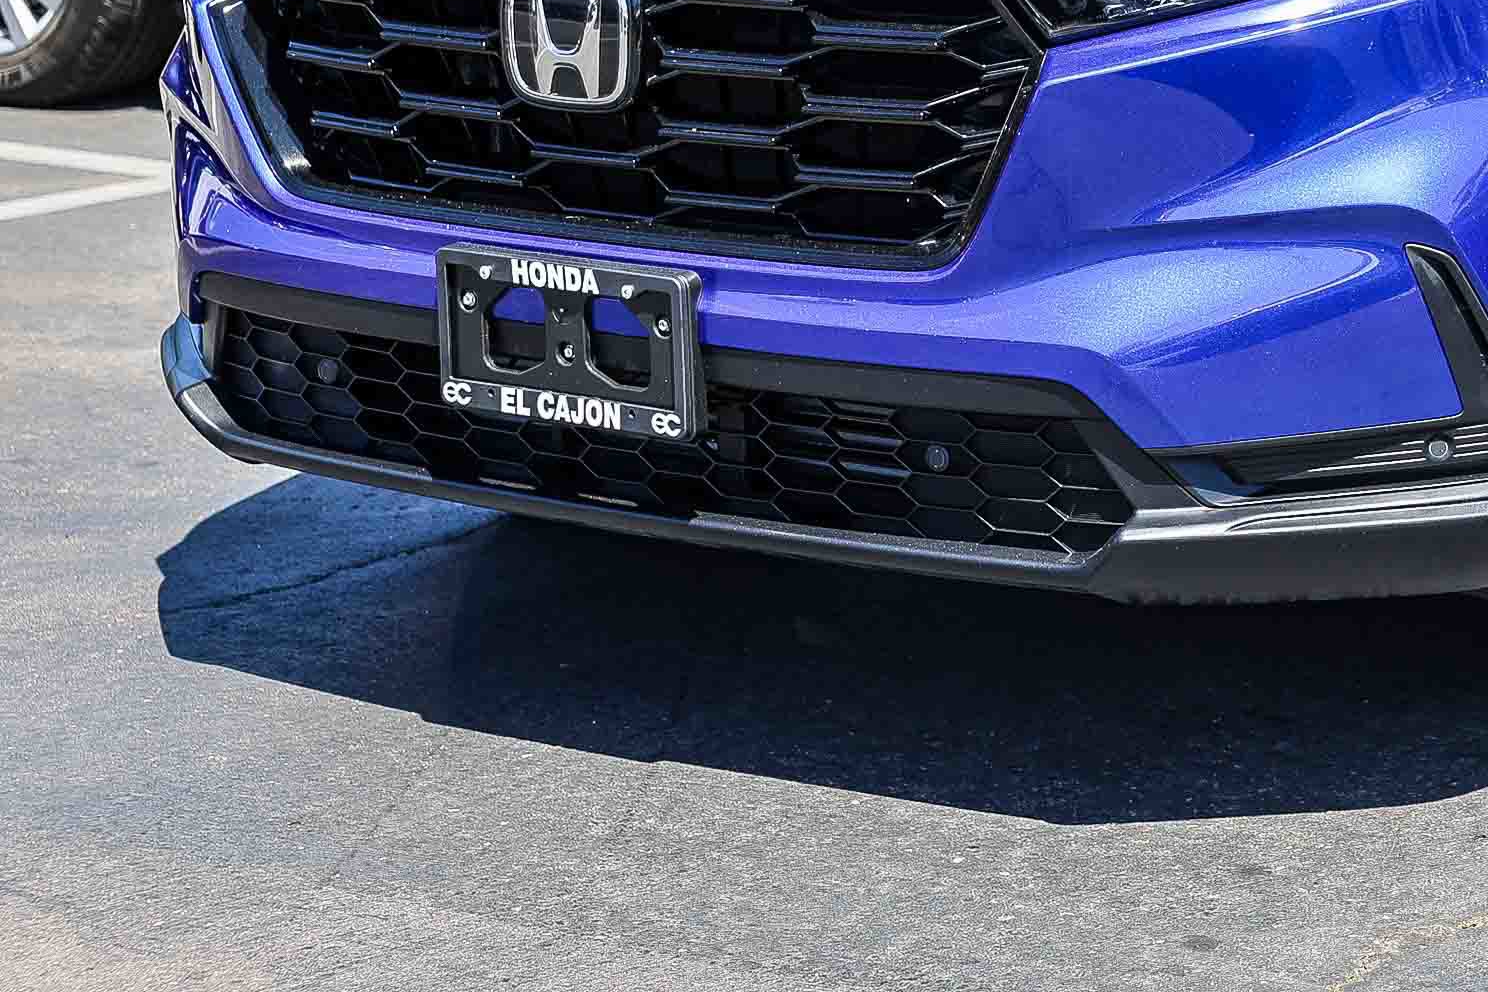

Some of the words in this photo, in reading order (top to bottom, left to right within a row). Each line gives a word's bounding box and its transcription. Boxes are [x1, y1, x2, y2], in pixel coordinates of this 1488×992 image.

[510, 258, 600, 295] HONDA
[500, 386, 532, 417] EL
[536, 392, 622, 431] CAJON
